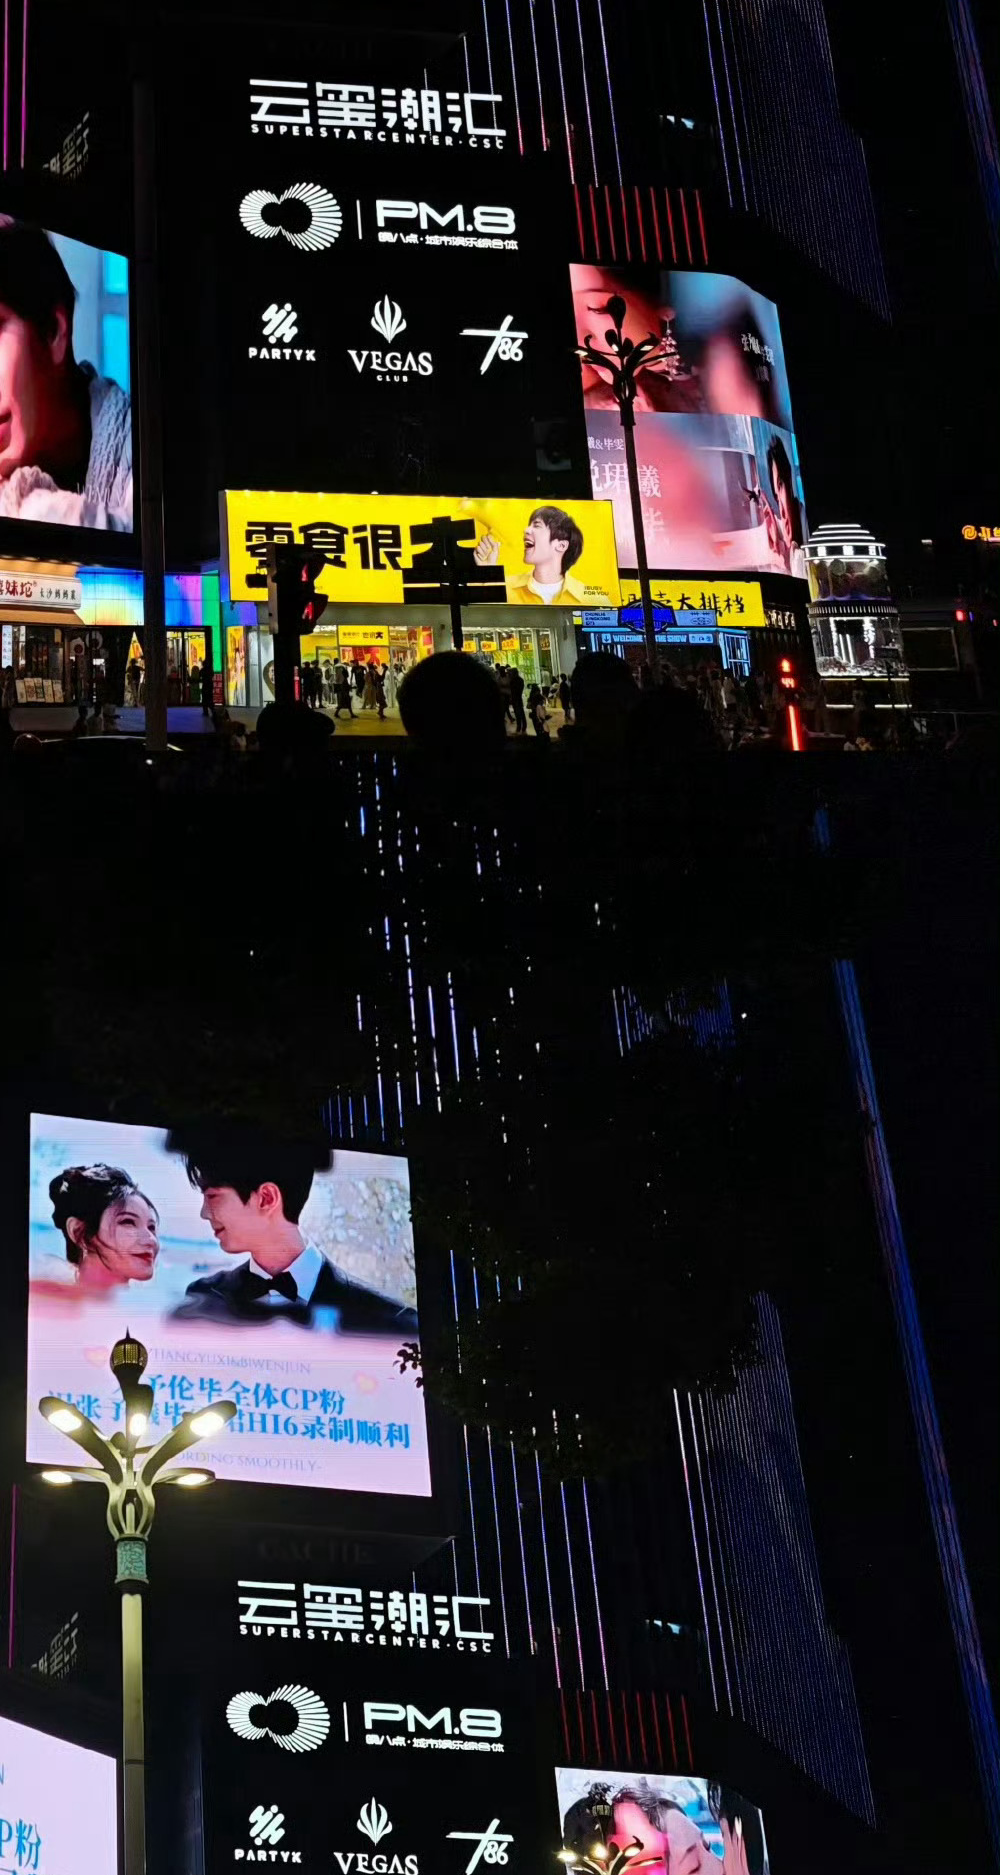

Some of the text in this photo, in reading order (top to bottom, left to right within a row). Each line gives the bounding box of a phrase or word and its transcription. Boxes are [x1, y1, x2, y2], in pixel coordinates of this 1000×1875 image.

[376, 199, 515, 235] PM.8
[248, 346, 316, 361] PARTYK
[349, 349, 434, 376] VEGAS
[377, 375, 408, 384] CLUB
[363, 1702, 502, 1738] PM.8
[234, 1848, 302, 1863] PARTYK
